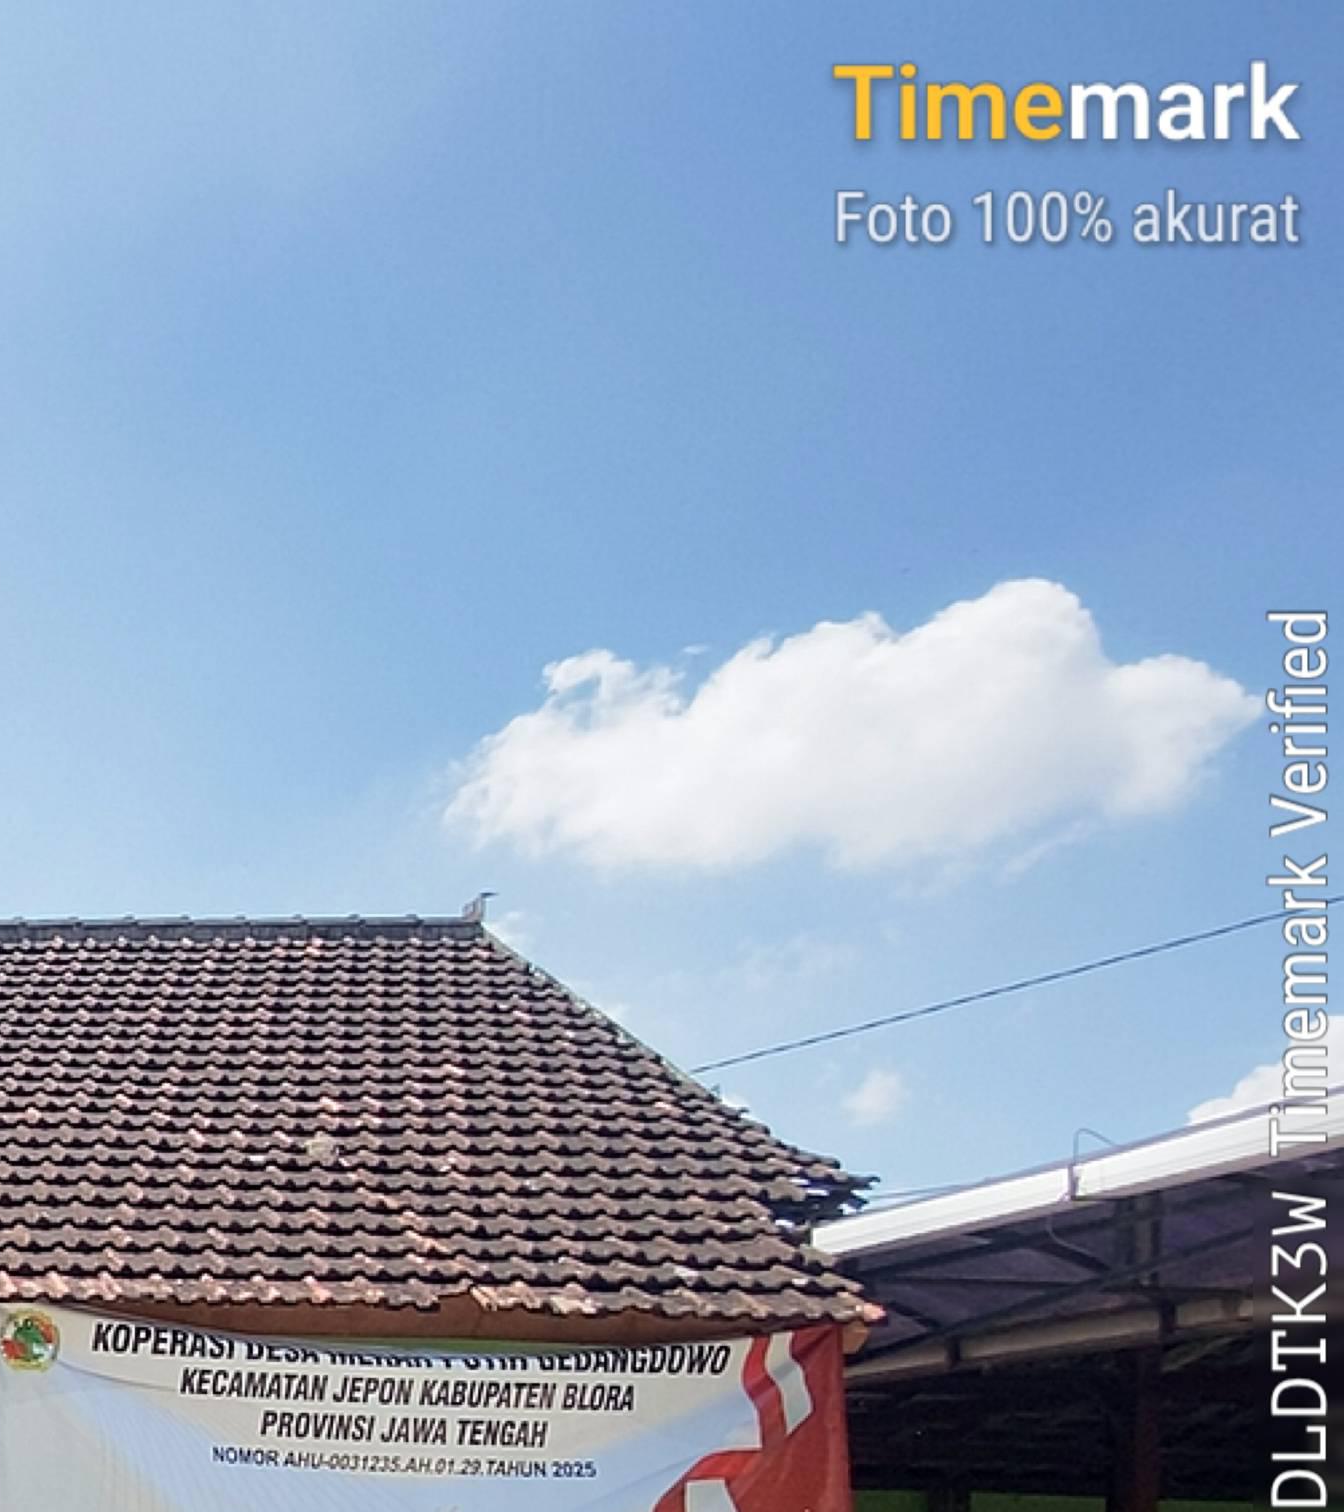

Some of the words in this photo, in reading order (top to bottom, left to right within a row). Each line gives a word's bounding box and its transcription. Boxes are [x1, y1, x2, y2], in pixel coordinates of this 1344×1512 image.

[92, 1323, 235, 1359] KOPERASI
[180, 1368, 328, 1401] KECAMATAN
[332, 1375, 415, 1405] JEPON
[419, 1379, 557, 1409] KABUPATEN
[562, 1384, 635, 1411] BLORA
[260, 1411, 376, 1443] PROVINSI
[380, 1417, 447, 1446] JAWA
[456, 1420, 549, 1448] TENGAH
[212, 1446, 279, 1467] NOMOR
[552, 1460, 597, 1478] 2025
